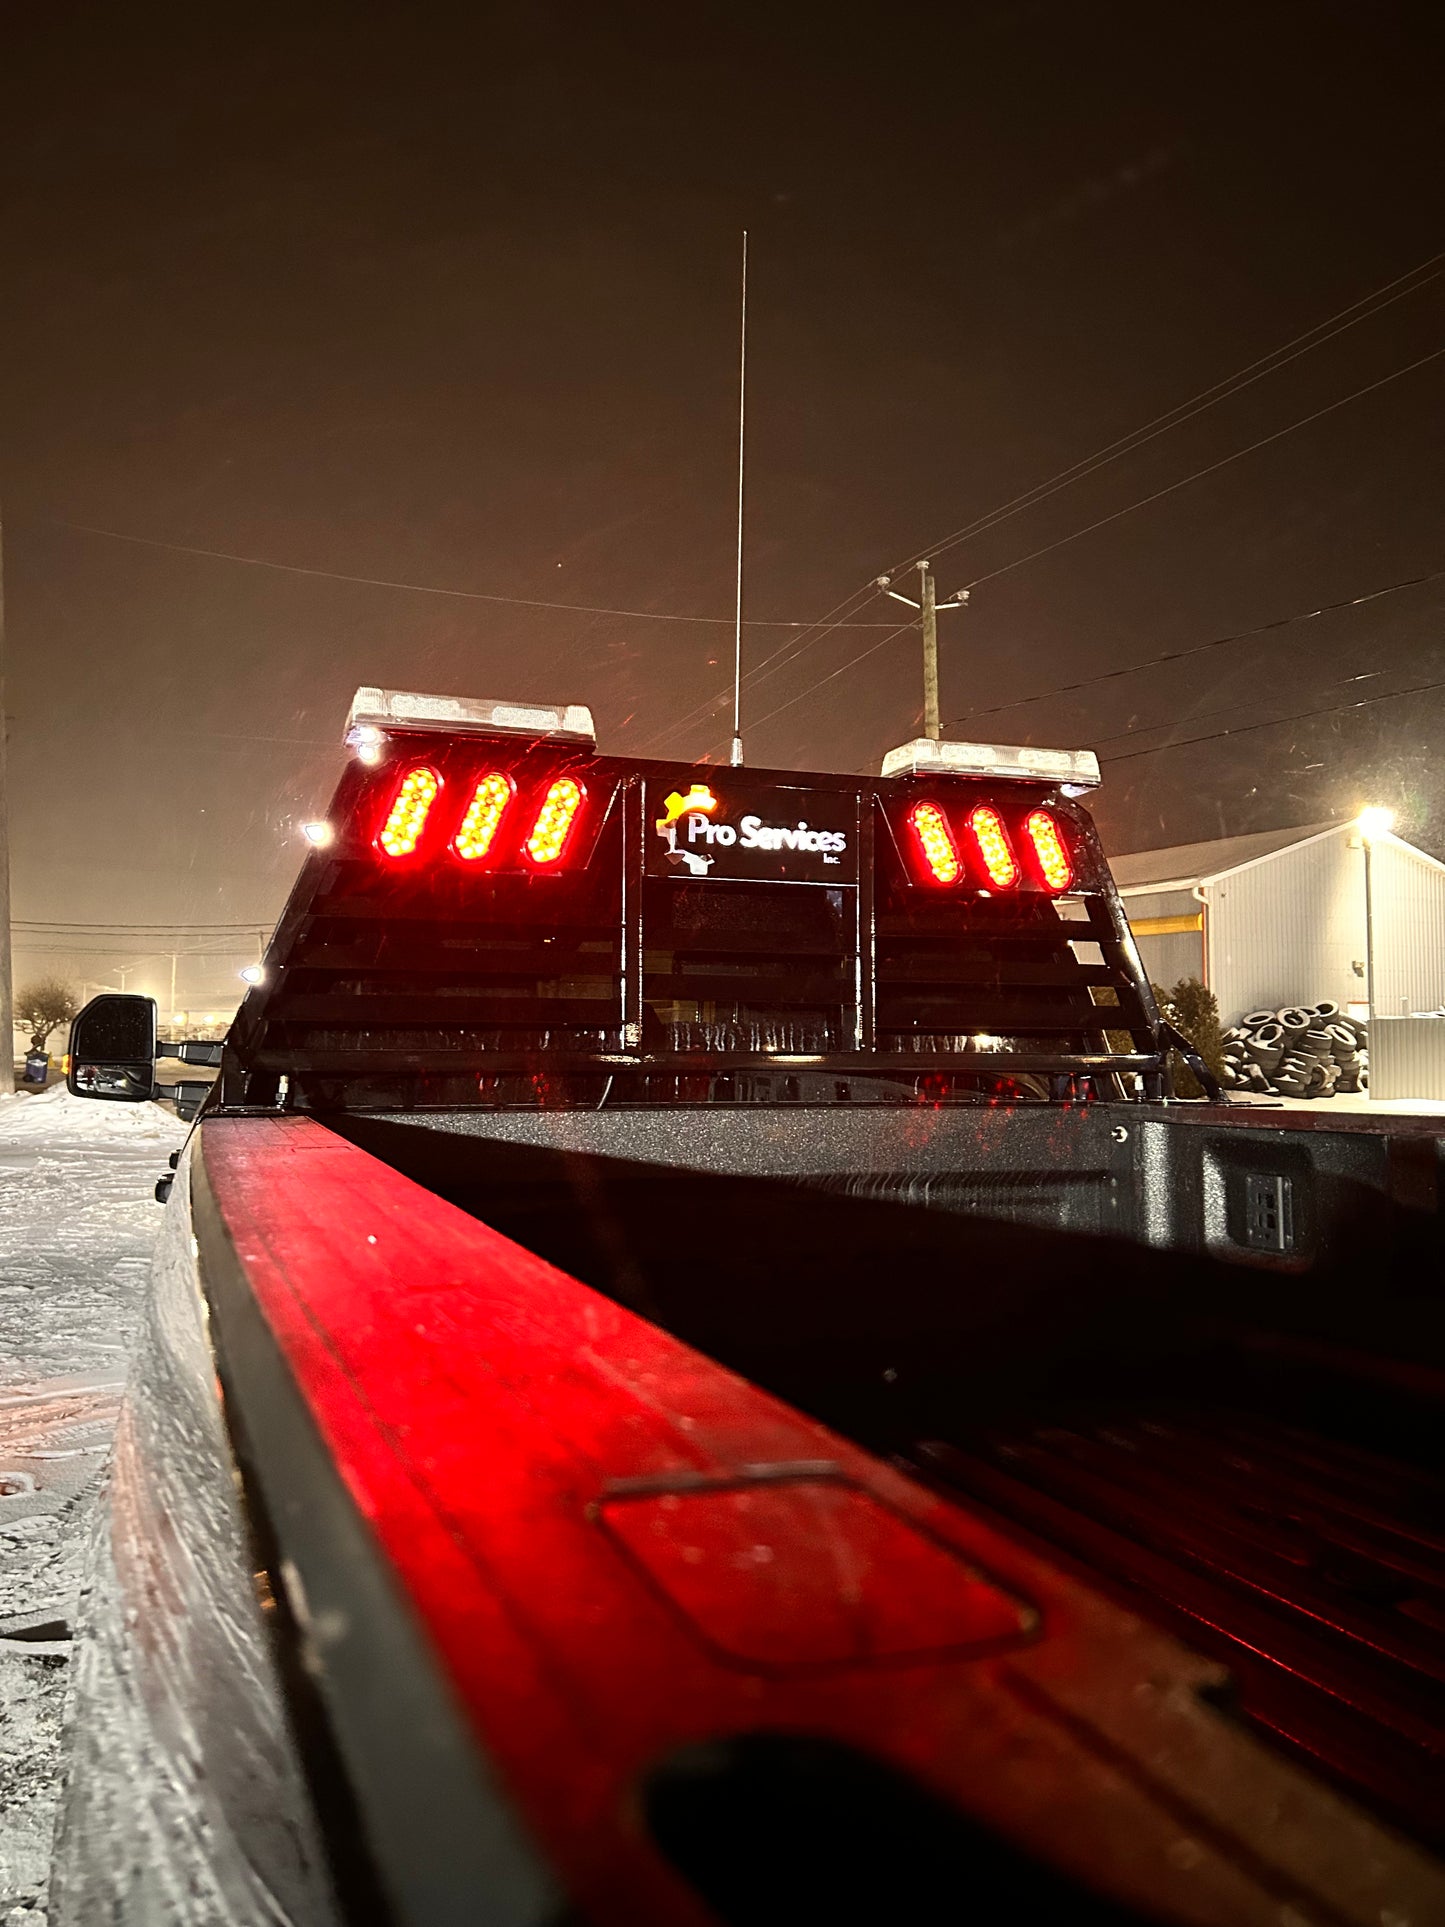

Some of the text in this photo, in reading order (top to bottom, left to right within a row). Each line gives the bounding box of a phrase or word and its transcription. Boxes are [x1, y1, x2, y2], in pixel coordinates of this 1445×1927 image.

[688, 813, 847, 852] Pro Services
[823, 853, 841, 864] Inc.
